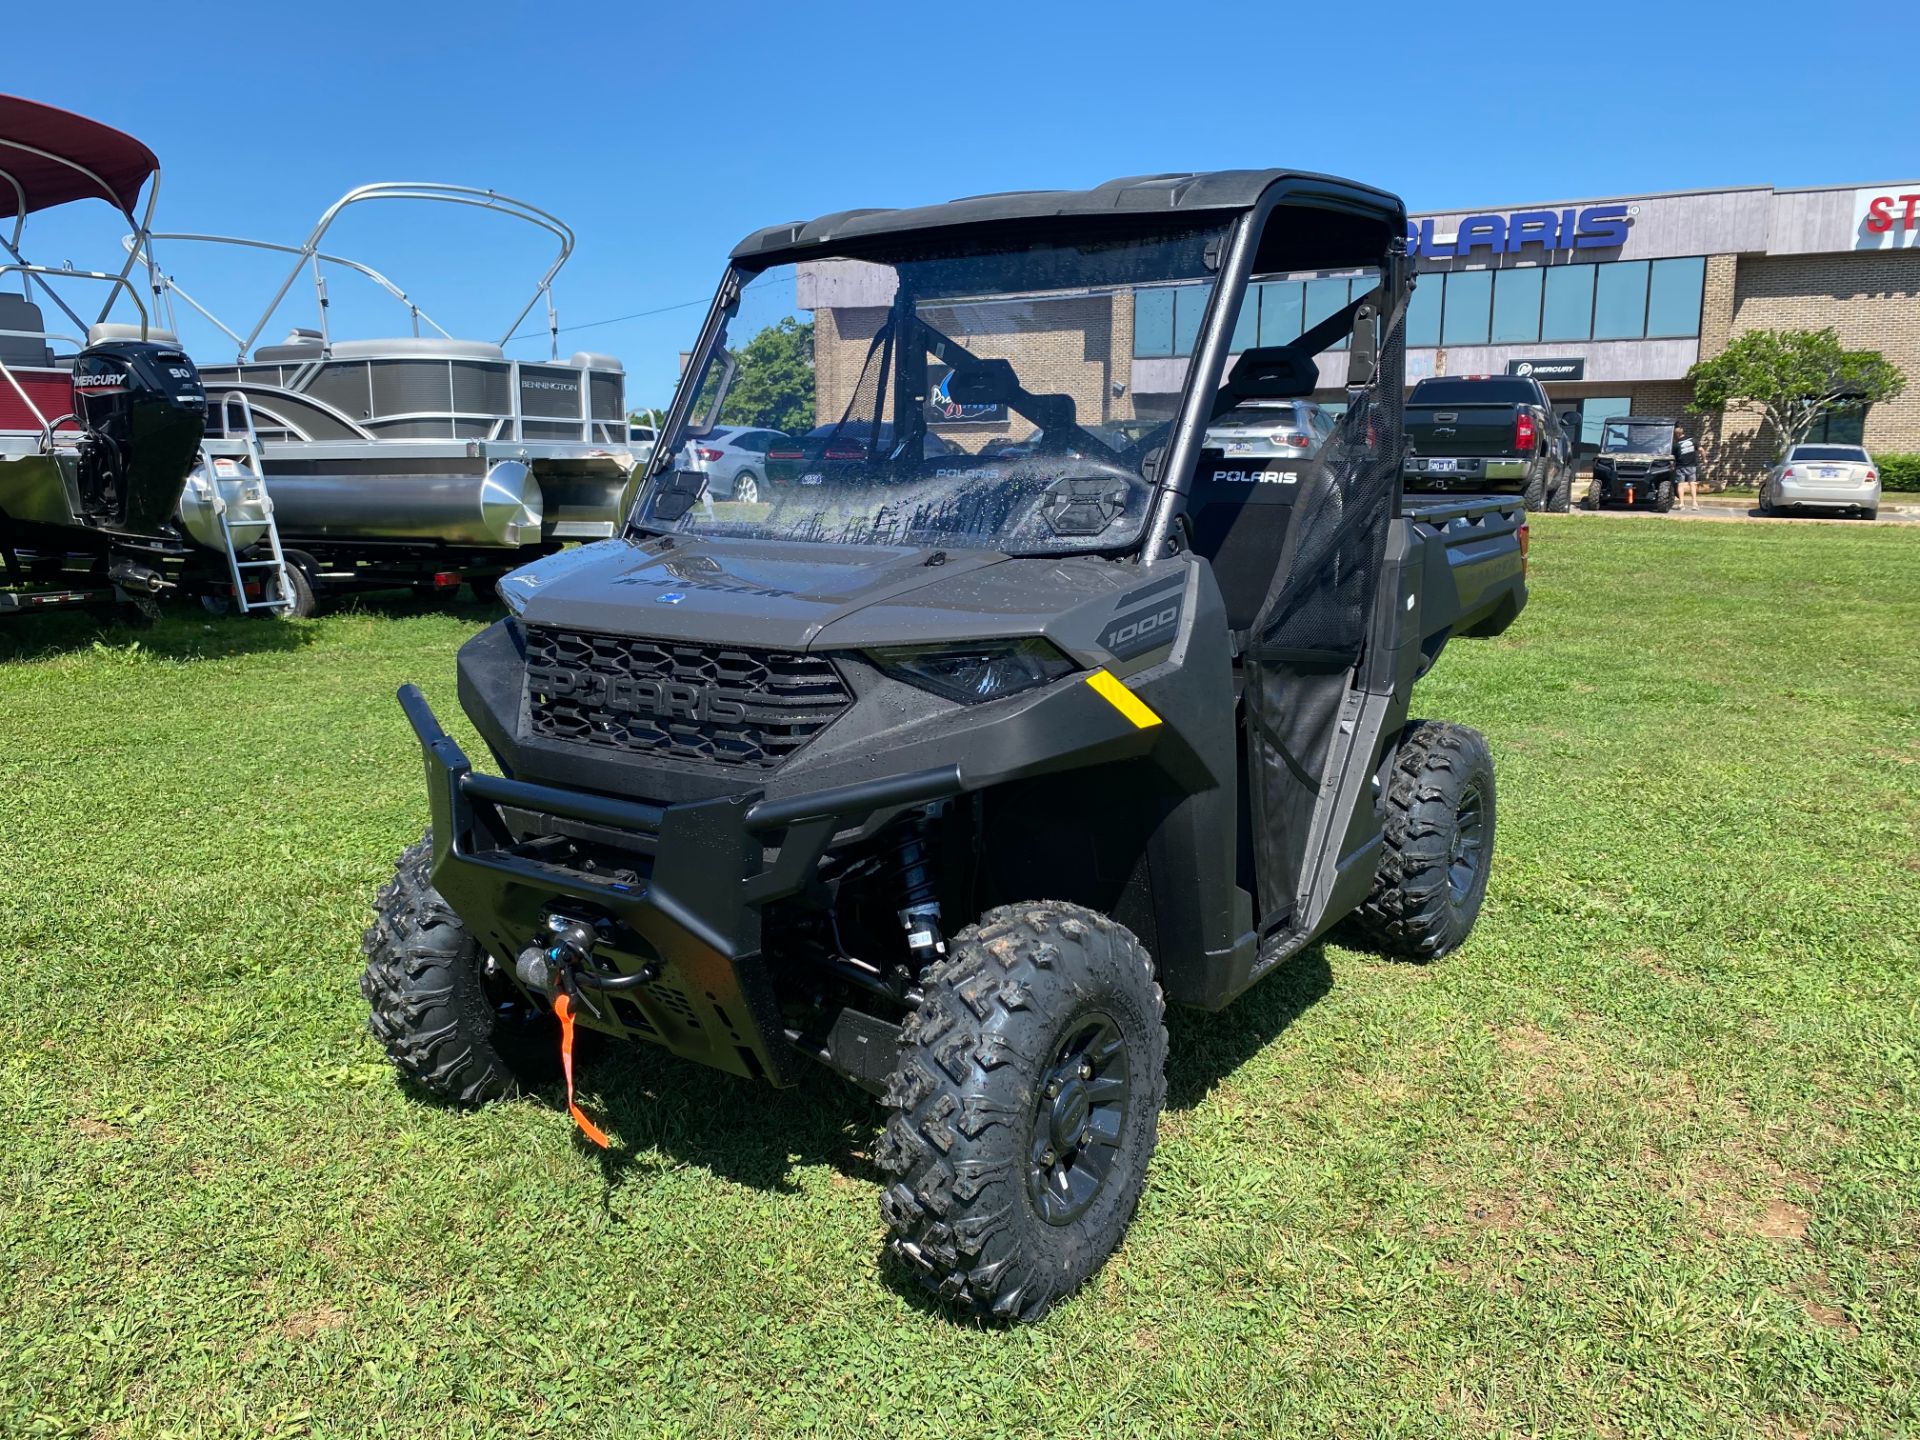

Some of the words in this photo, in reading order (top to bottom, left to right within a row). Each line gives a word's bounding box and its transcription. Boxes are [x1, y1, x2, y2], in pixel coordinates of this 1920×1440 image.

[169, 368, 190, 378] 90
[1533, 366, 1576, 374] MERCURY
[73, 374, 127, 387] MERCURY
[521, 380, 578, 392] BENNINGTON
[935, 468, 1000, 479] POLARIS
[1212, 470, 1298, 484] POLARIS
[1108, 606, 1177, 648] 1000
[546, 667, 746, 726] POLARIS
